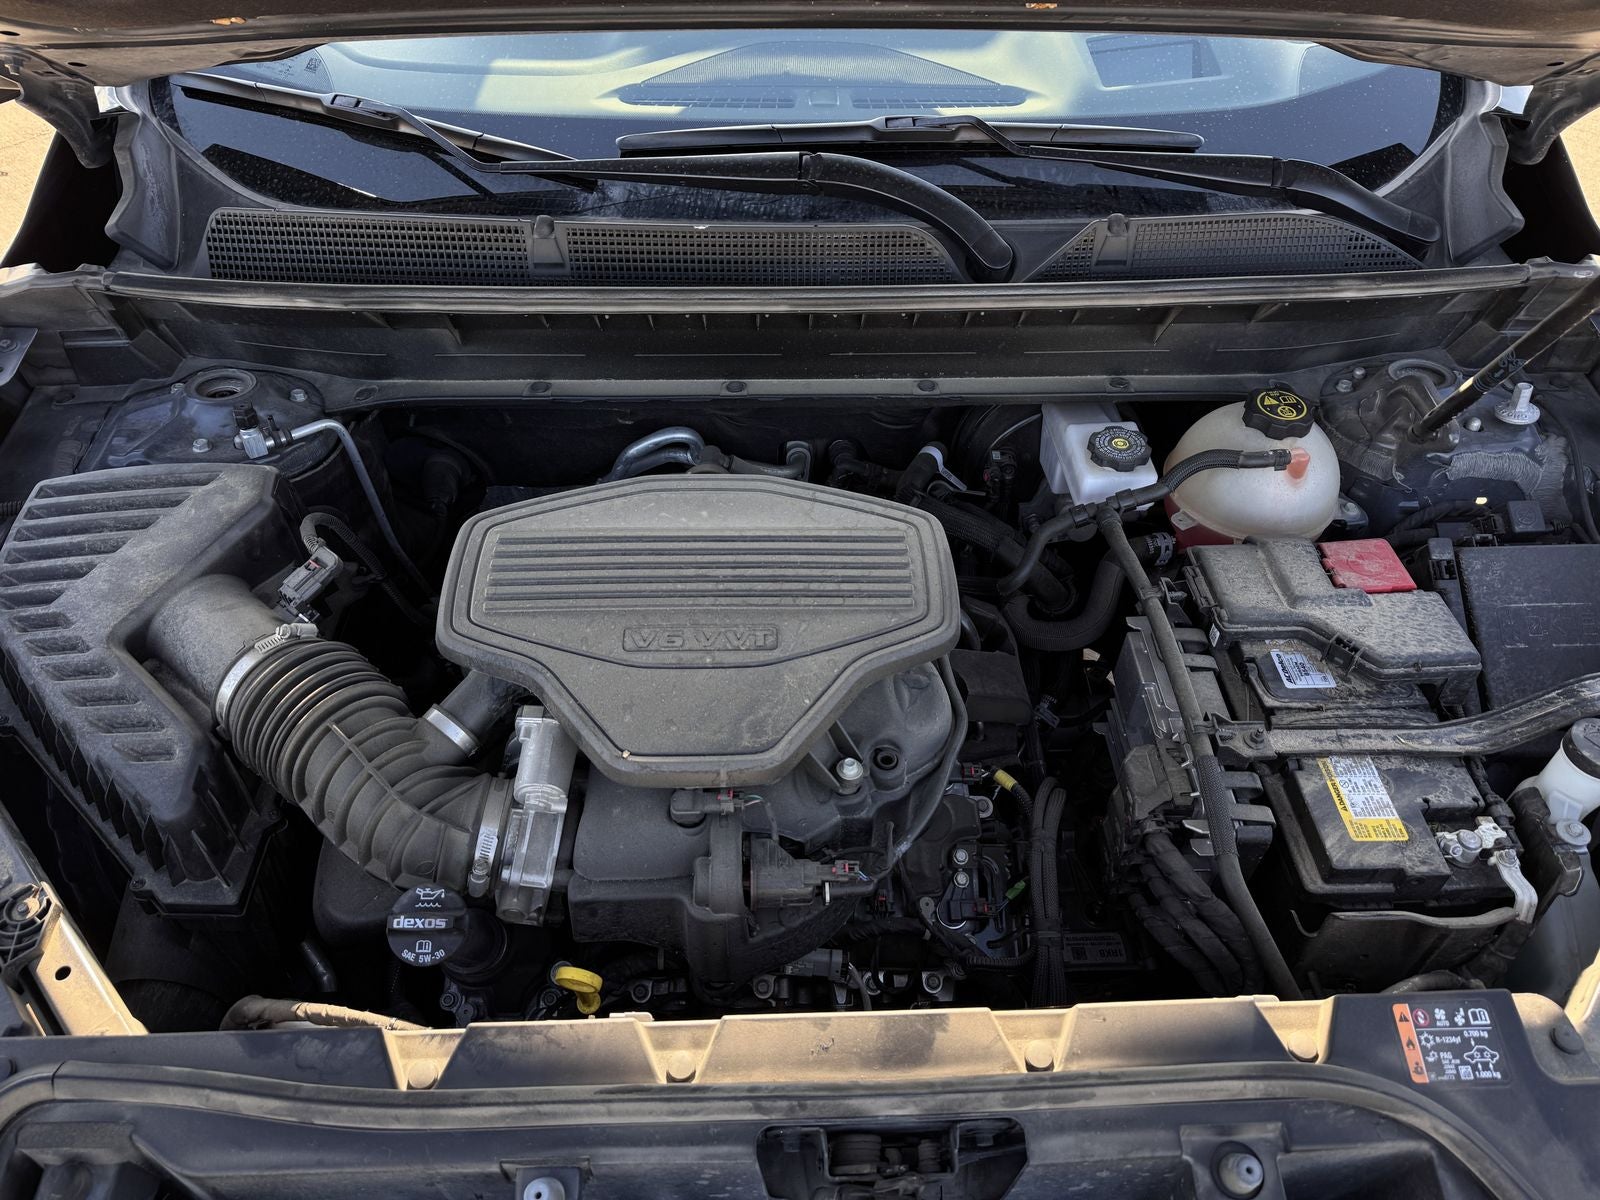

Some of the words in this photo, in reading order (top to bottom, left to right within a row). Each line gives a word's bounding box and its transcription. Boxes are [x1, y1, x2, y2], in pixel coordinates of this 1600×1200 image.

[629, 629, 685, 648] V6
[695, 629, 772, 648] VVT
[1331, 782, 1345, 806] DANGER
[393, 915, 448, 929] dexos
[401, 949, 416, 962] SAE
[418, 949, 445, 963] 5W-30
[1435, 1036, 1461, 1044] R-1234yf
[1480, 1030, 1488, 1039] kg
[1492, 1071, 1501, 1079] kg
